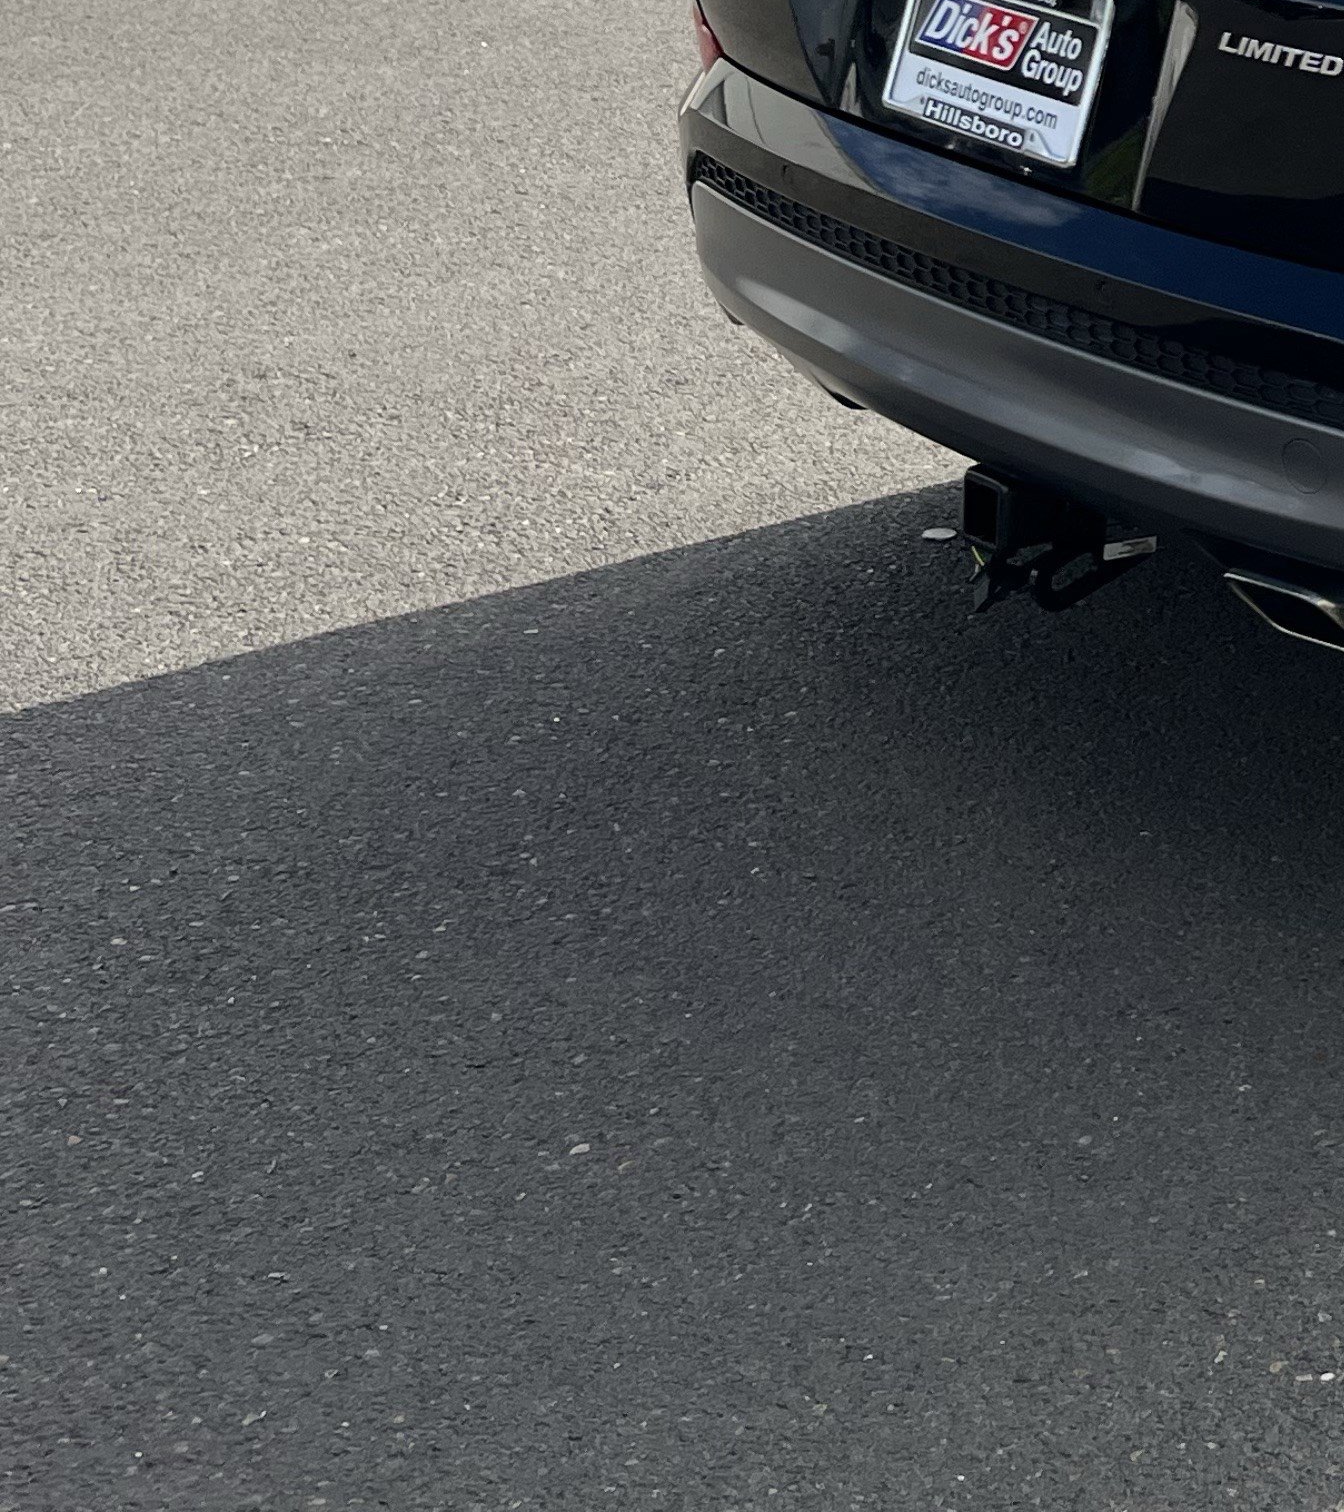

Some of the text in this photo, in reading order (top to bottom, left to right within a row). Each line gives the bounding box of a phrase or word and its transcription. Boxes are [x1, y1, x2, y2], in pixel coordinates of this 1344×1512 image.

[924, 0, 1019, 61] Dick's
[1030, 21, 1083, 61] Auto
[1217, 31, 1344, 77] LIMITED
[1021, 49, 1084, 96] Group
[916, 67, 1059, 129] dicksautogroup.com
[924, 98, 1024, 148] Hillsboro
